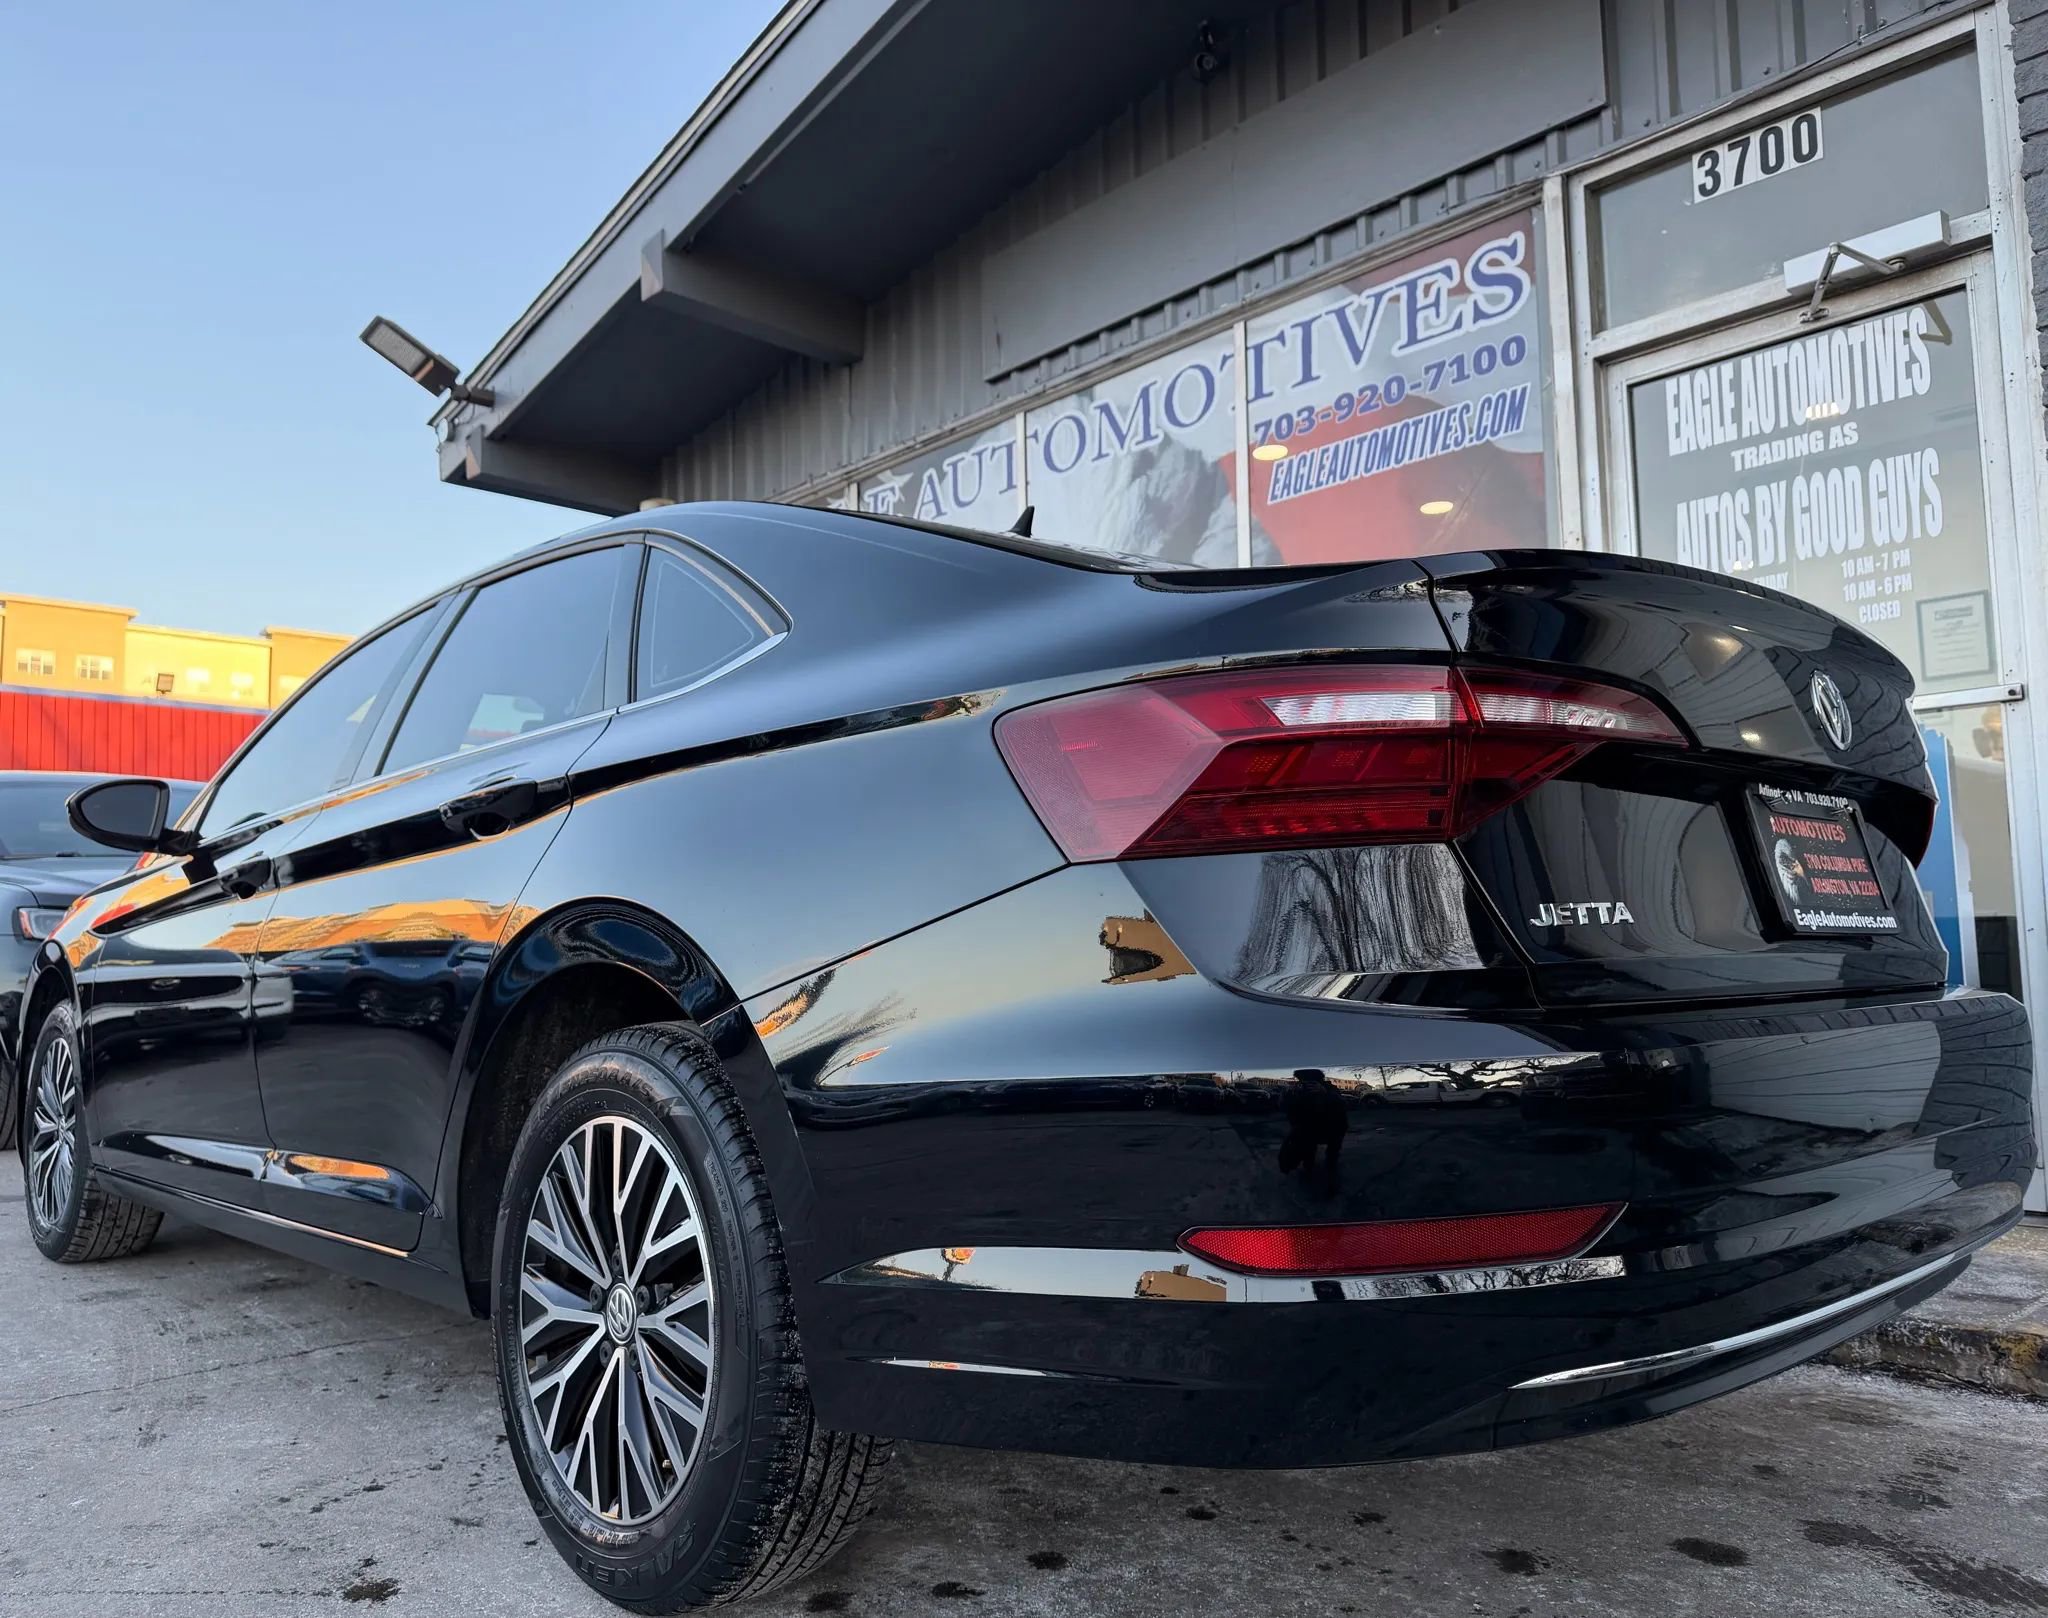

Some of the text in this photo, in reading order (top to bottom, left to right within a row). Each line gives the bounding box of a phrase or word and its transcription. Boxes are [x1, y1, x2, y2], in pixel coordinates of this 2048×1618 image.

[1697, 112, 1818, 197] 3700
[917, 236, 1527, 519] AUTOMOTIVES
[1254, 335, 1527, 446] 703-920-7100
[1665, 307, 1931, 456] EAGLE AUTOMOTIVES
[1271, 386, 1530, 502] EAGLEAUTOMOTIVES.COM
[1731, 422, 1858, 472] TRADING AS
[1676, 447, 1943, 574] AUTOS BY GOOD GUYS
[1841, 559, 1855, 578] 10
[1856, 555, 1874, 575] AM
[1892, 549, 1910, 568] PM
[1843, 583, 1857, 602] 10
[1858, 579, 1876, 599] AM
[1884, 577, 1893, 595] 6
[1893, 572, 1912, 593] PM
[1859, 599, 1900, 624] CLOSED
[1769, 816, 1847, 842] AUTOMOTIVES
[1529, 902, 1634, 926] JETTA
[1794, 908, 1898, 930] EagleAutomotives.com
